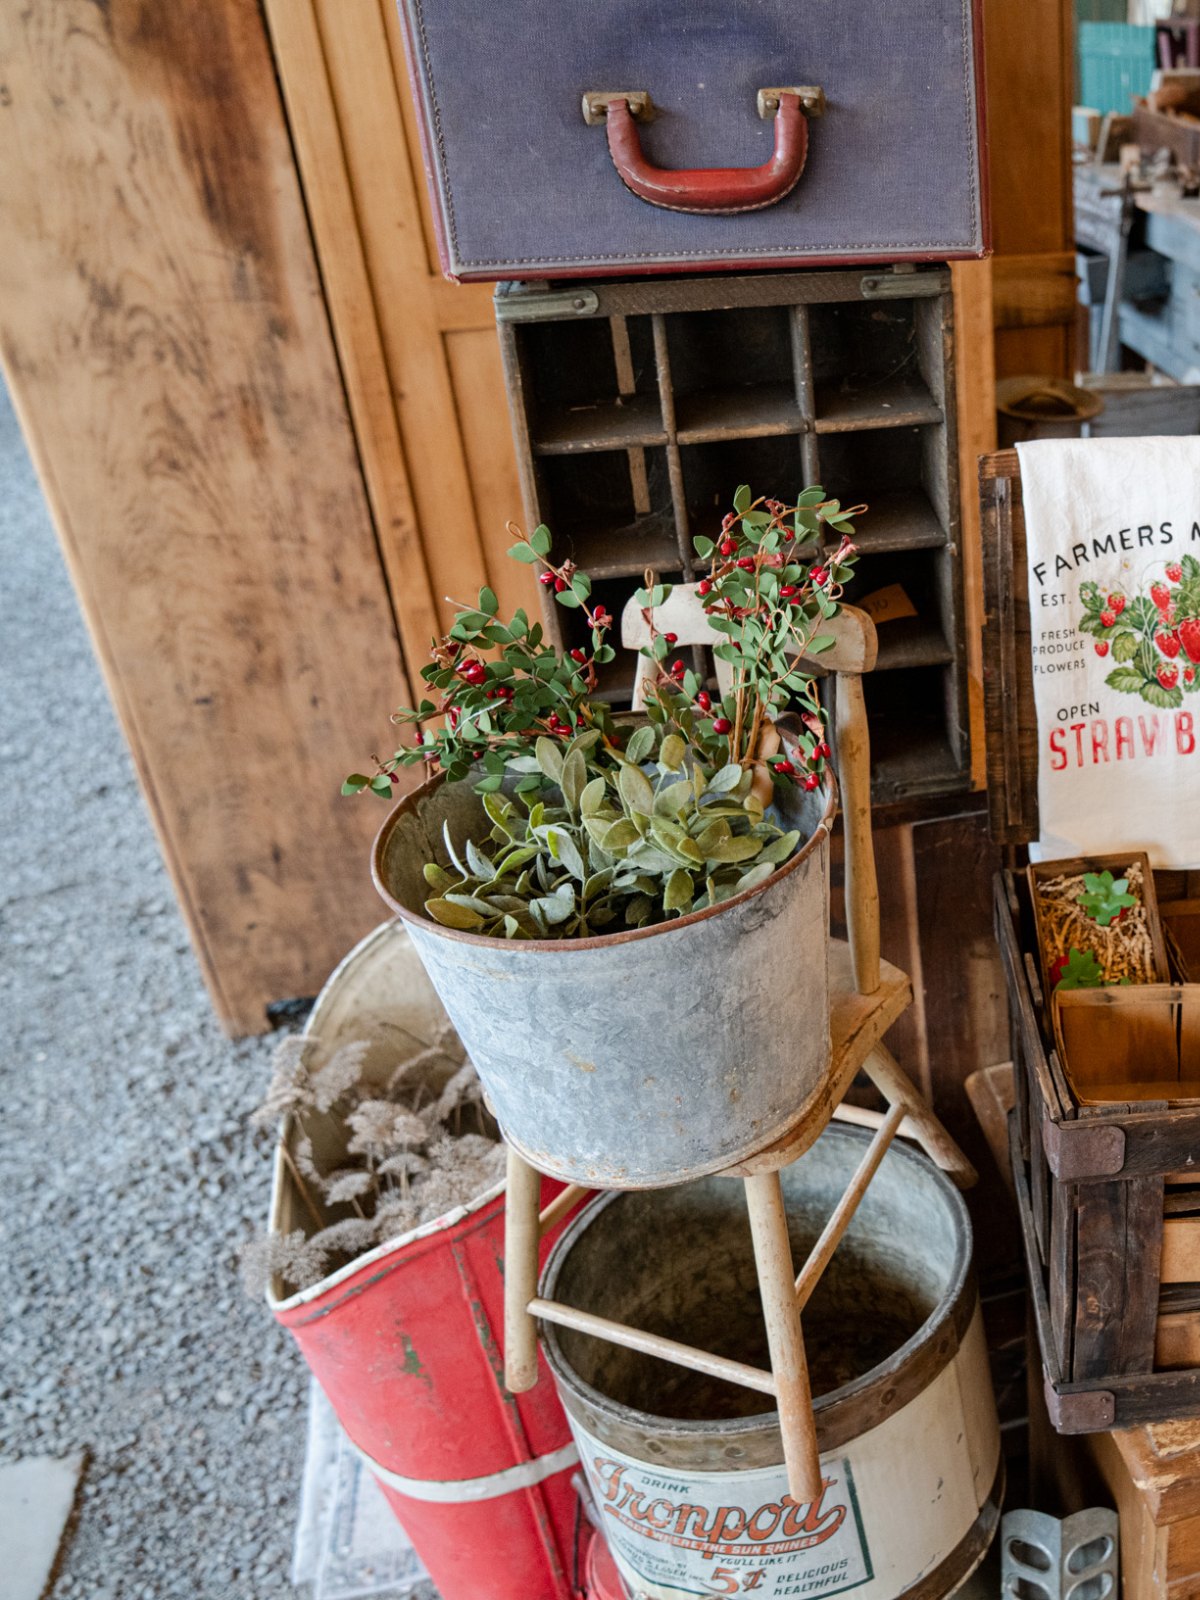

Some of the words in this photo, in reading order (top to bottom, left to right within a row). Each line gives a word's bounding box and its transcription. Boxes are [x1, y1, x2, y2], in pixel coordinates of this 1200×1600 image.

[1032, 521, 1174, 586] FARMERS
[1041, 593, 1072, 607] EST.
[1041, 628, 1076, 641] FRESH
[1033, 640, 1085, 656] PRODUCE
[1033, 659, 1086, 674] FLOWERS
[1057, 701, 1100, 721] OPEN
[641, 1476, 691, 1494] DRINK
[592, 1456, 846, 1560] Ironport
[701, 1541, 727, 1553] THE
[731, 1545, 762, 1555] SUN
[764, 1536, 819, 1555] SHINES
[759, 1557, 784, 1567] LIKE
[776, 1558, 849, 1584] DELICIOUS
[773, 1571, 849, 1597] HEALTHFUL
